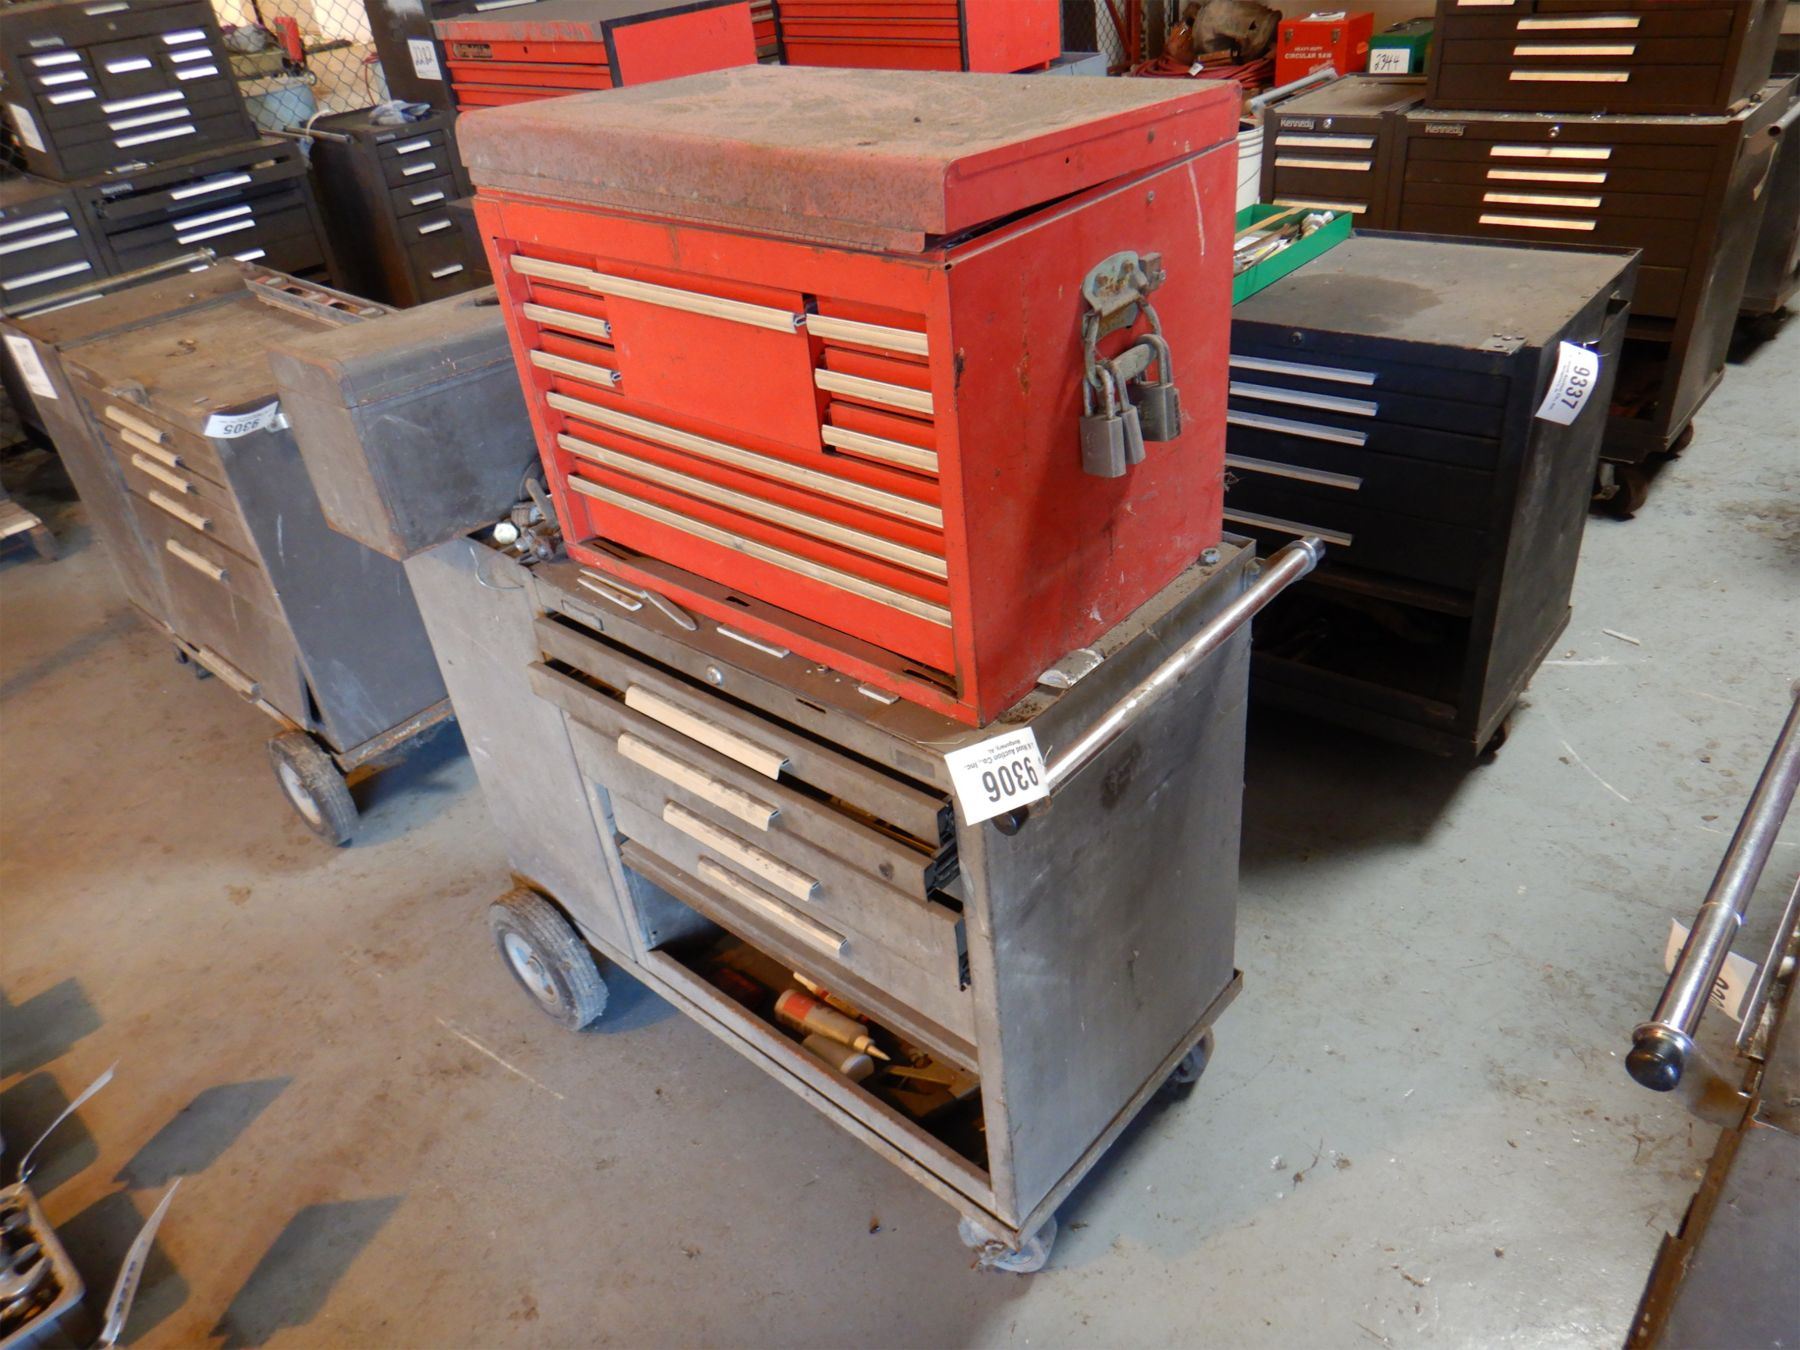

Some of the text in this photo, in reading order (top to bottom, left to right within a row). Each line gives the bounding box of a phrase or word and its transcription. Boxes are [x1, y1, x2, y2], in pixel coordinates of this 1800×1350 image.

[1280, 118, 1315, 129] Kennedy
[1424, 124, 1466, 136] Kennedy
[1561, 365, 1591, 410] 9337
[223, 418, 261, 435] 9305
[993, 748, 1016, 761] Auction
[982, 756, 1039, 802] 9306
